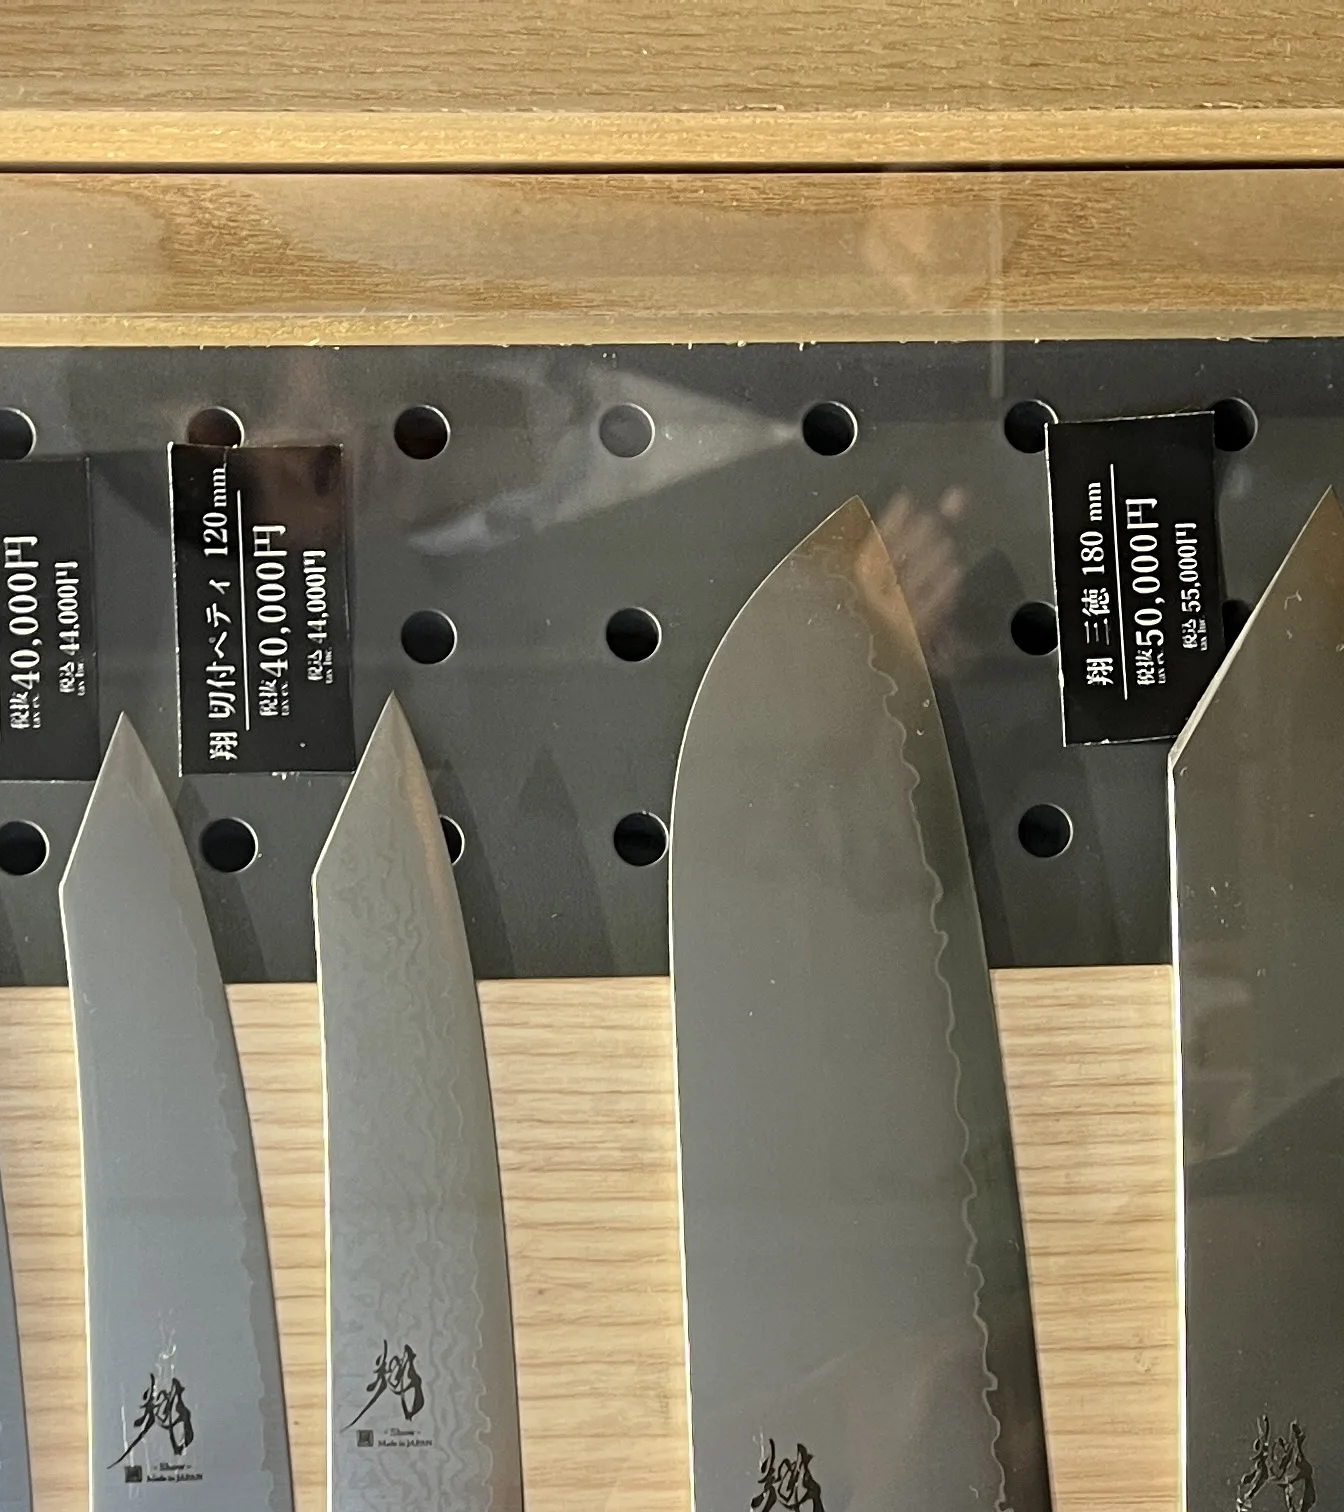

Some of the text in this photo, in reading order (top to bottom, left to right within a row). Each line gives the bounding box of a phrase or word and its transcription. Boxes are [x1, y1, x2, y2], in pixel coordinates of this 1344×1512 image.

[4, 536, 43, 729] 税抜 40,000円
[55, 561, 80, 693] 税込 44,000円
[206, 579, 236, 719] 切付ペティ
[253, 525, 291, 717] 税抜 40,000円
[303, 550, 329, 681] 税込 44,000円
[1080, 482, 1114, 686] 翔 三徳 180 mm
[1126, 498, 1166, 686] 税抜 50,000円
[1175, 522, 1202, 649] 税込 55,000円
[210, 731, 238, 761] 翔
